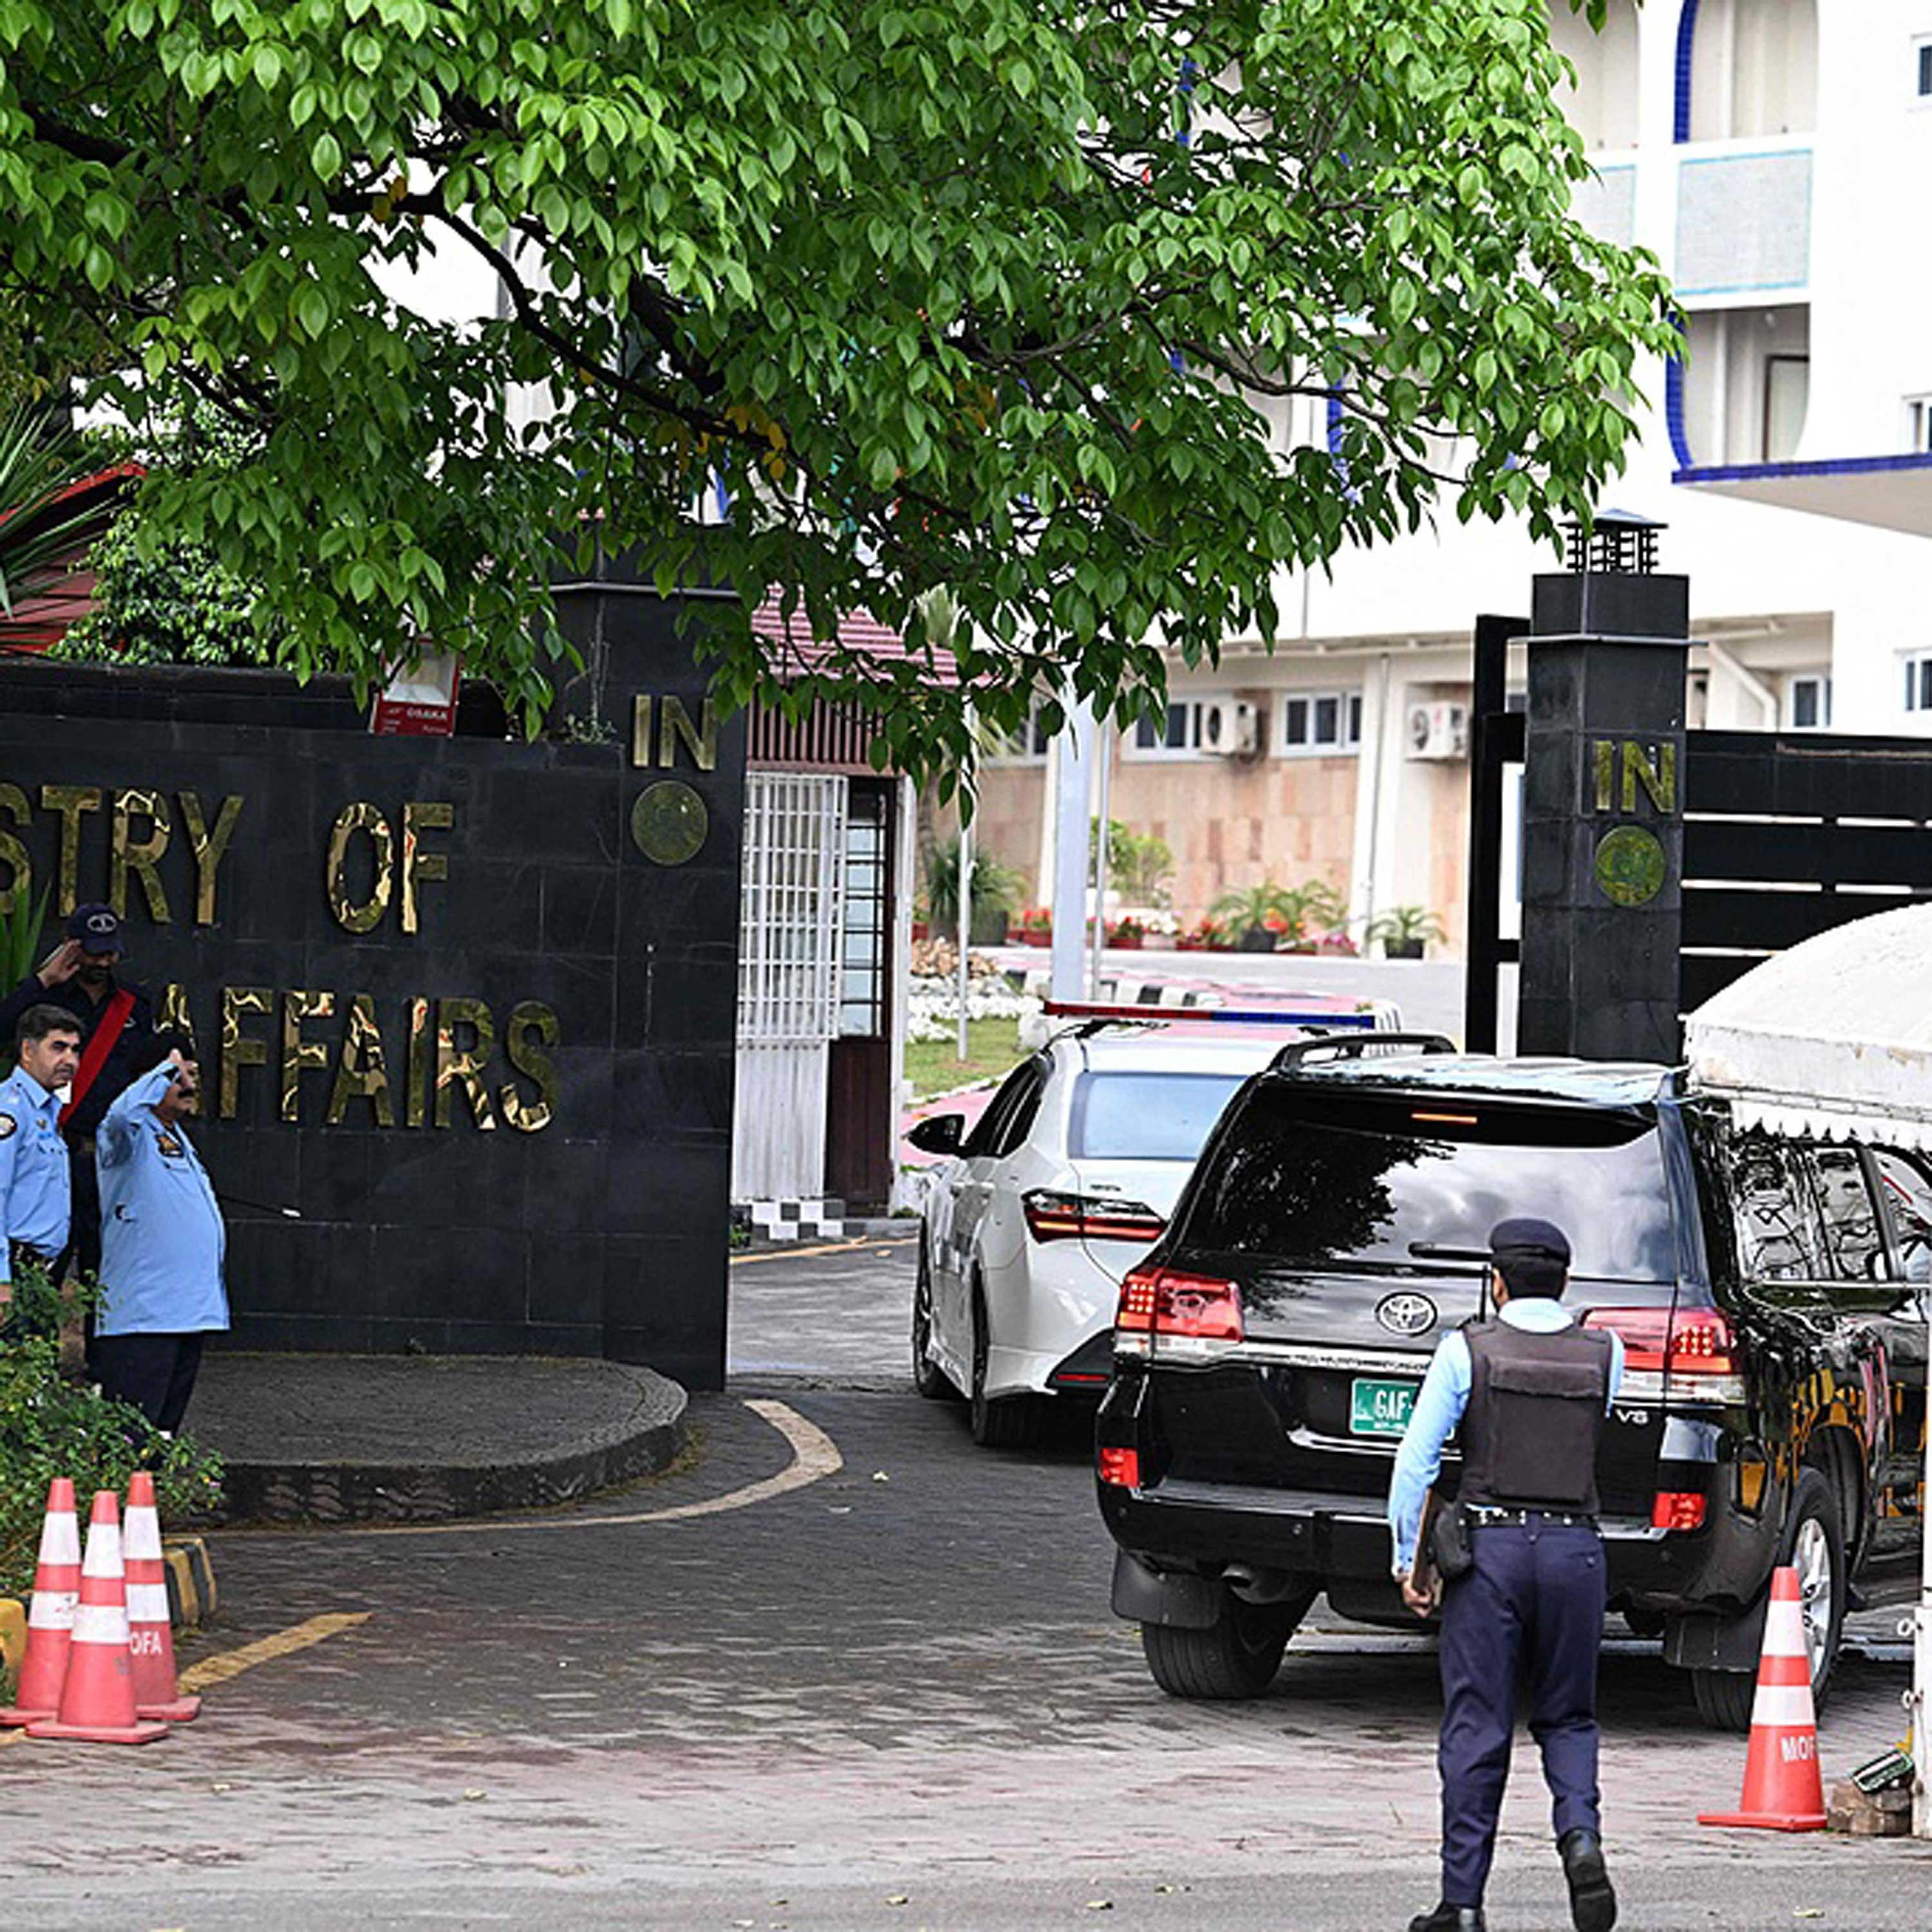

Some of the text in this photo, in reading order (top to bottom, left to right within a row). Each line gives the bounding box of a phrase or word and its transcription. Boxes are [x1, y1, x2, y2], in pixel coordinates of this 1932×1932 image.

[634, 695, 717, 770] IN
[1594, 741, 1675, 812] IN
[328, 802, 453, 934] OF
